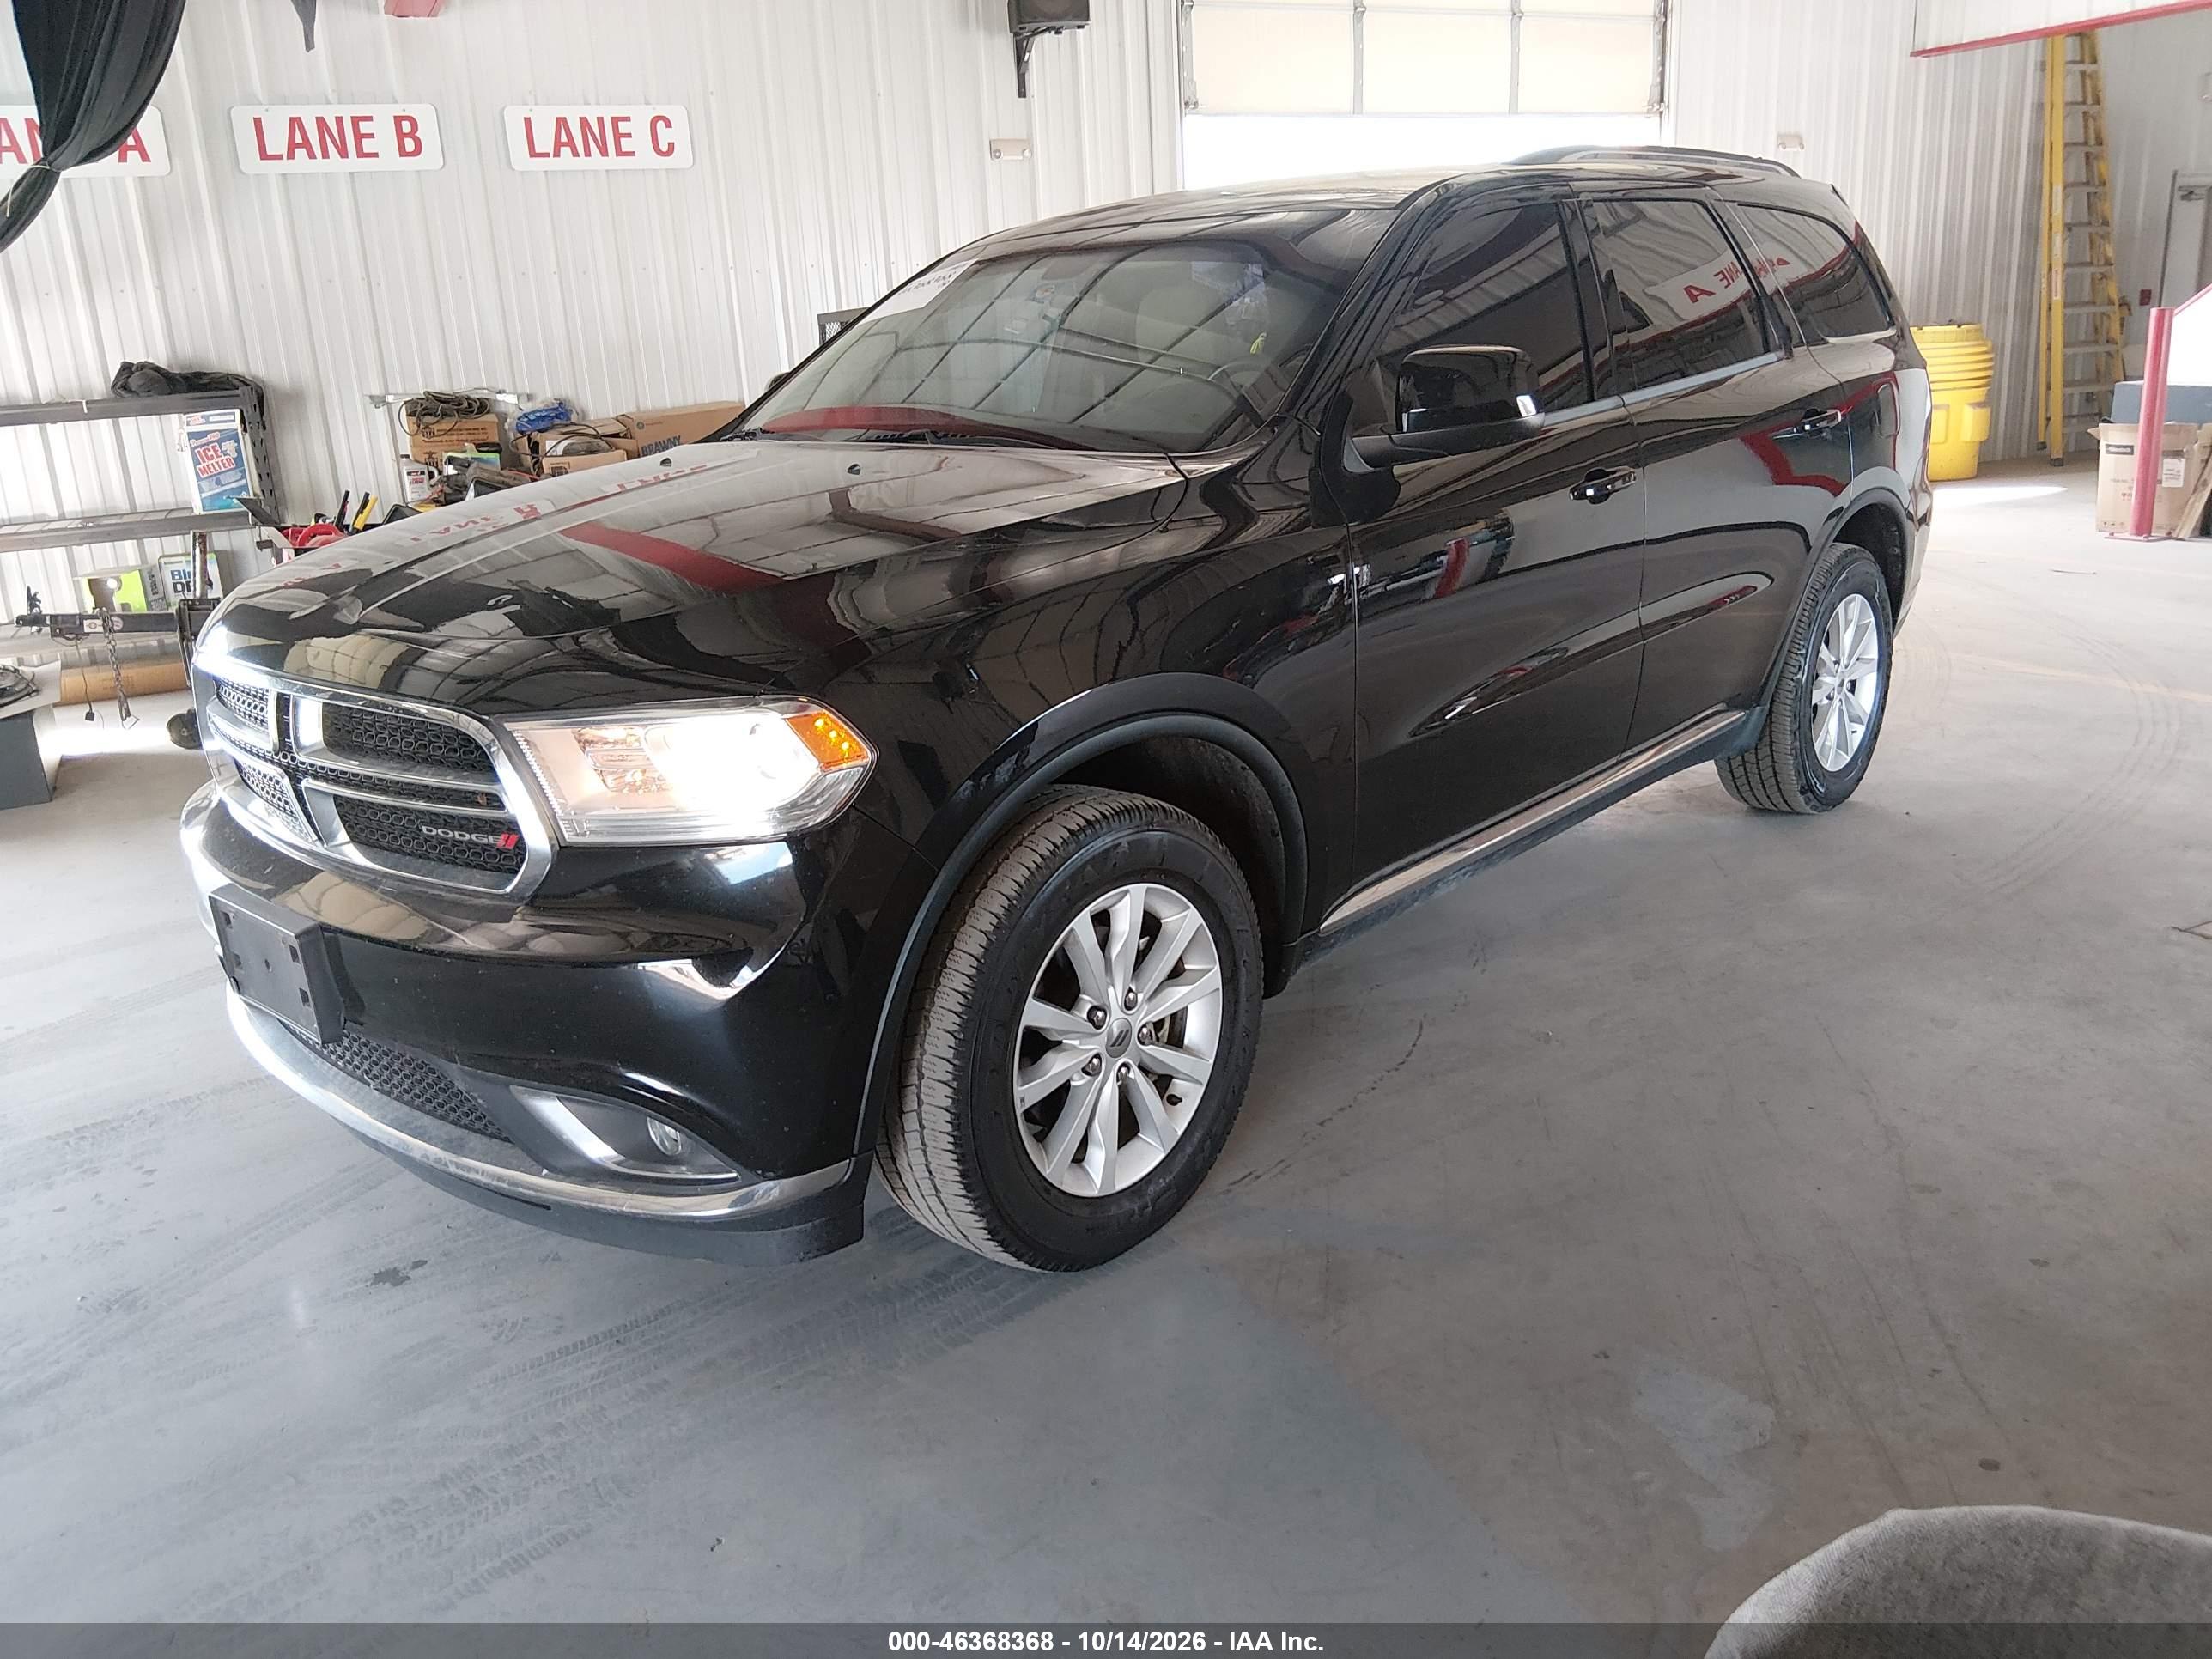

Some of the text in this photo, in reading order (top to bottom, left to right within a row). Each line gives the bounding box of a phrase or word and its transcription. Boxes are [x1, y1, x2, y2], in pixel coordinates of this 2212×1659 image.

[253, 115, 422, 161] LANE B
[524, 115, 675, 158] LANE C
[197, 444, 222, 464] ICE
[641, 435, 680, 457] BRAWNY
[198, 456, 234, 477] MELTER
[422, 825, 501, 844] DODGE
